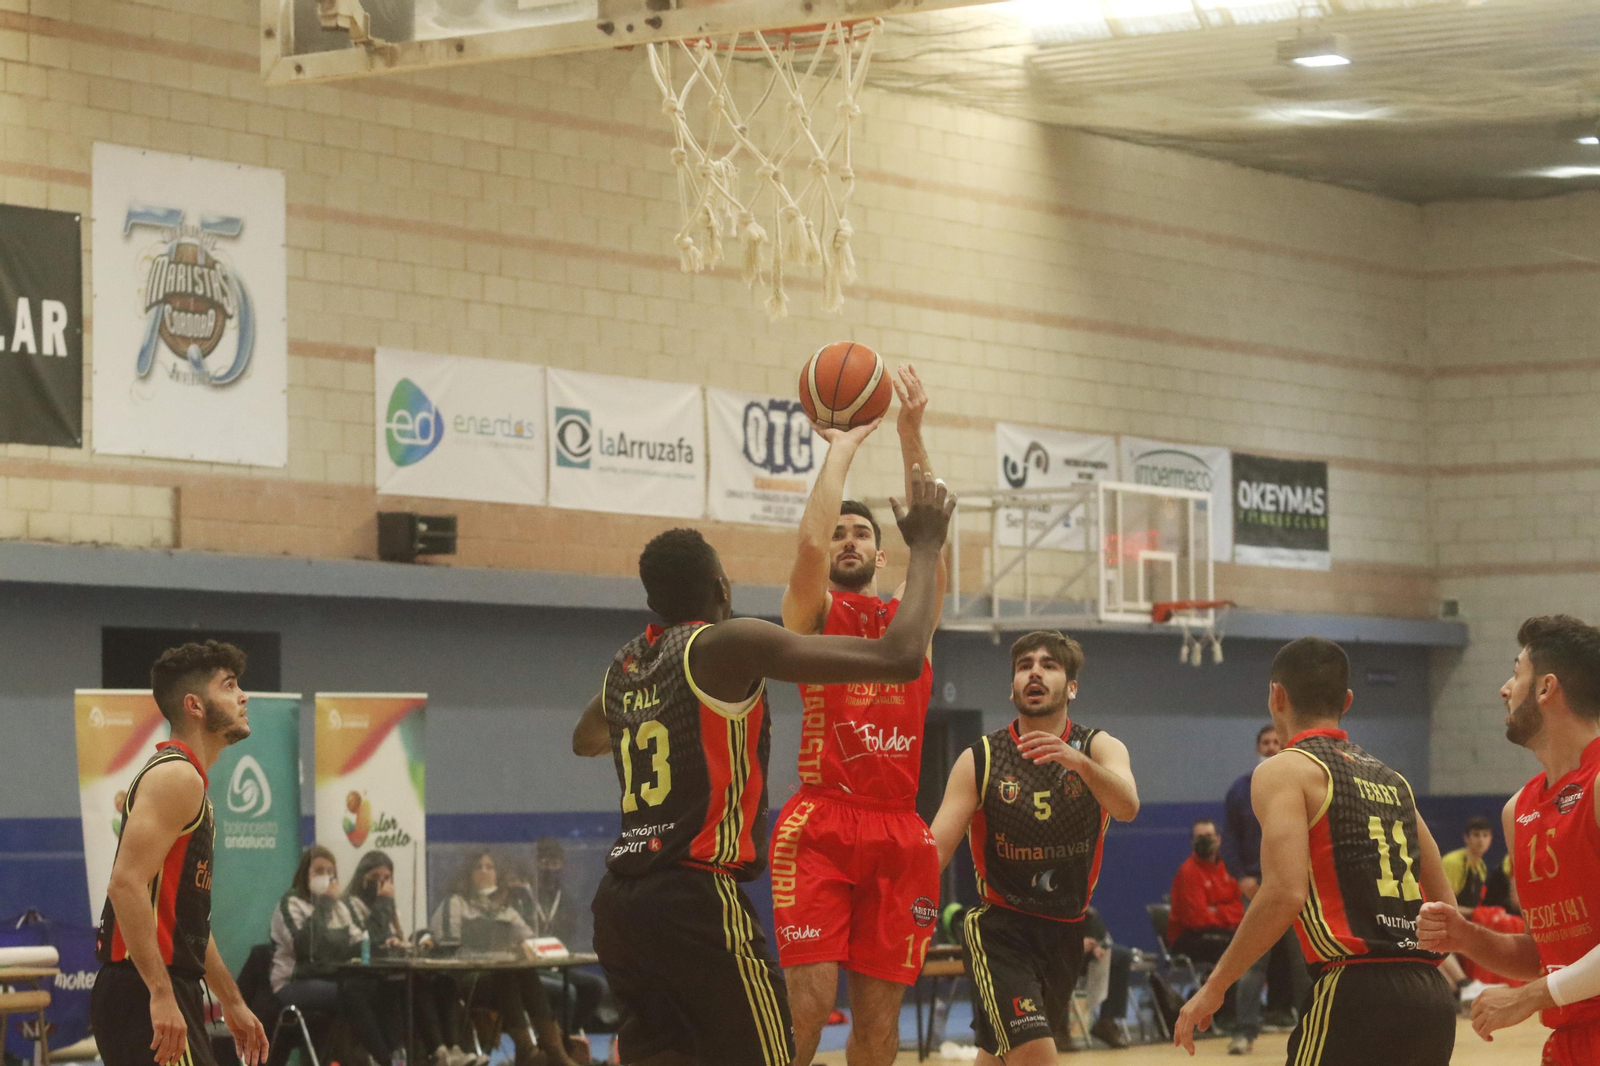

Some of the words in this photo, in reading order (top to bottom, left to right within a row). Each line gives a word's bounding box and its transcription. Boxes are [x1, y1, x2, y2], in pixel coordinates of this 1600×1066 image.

[146, 253, 233, 319] MARISTAS
[0, 297, 68, 357] AR
[599, 428, 694, 464] laArruzafa
[1238, 480, 1325, 516] OKEYMAS
[623, 684, 660, 714] FALL
[854, 723, 917, 753] Folder
[621, 719, 672, 814] 13
[1033, 790, 1052, 821] 5
[1353, 776, 1402, 806] TERRY
[773, 800, 815, 910] CORDOBA
[1367, 815, 1423, 901] 11
[1527, 827, 1559, 883] 15
[781, 924, 822, 942] Folder
[1522, 903, 1560, 931] DESDE
[54, 969, 98, 991] molte
